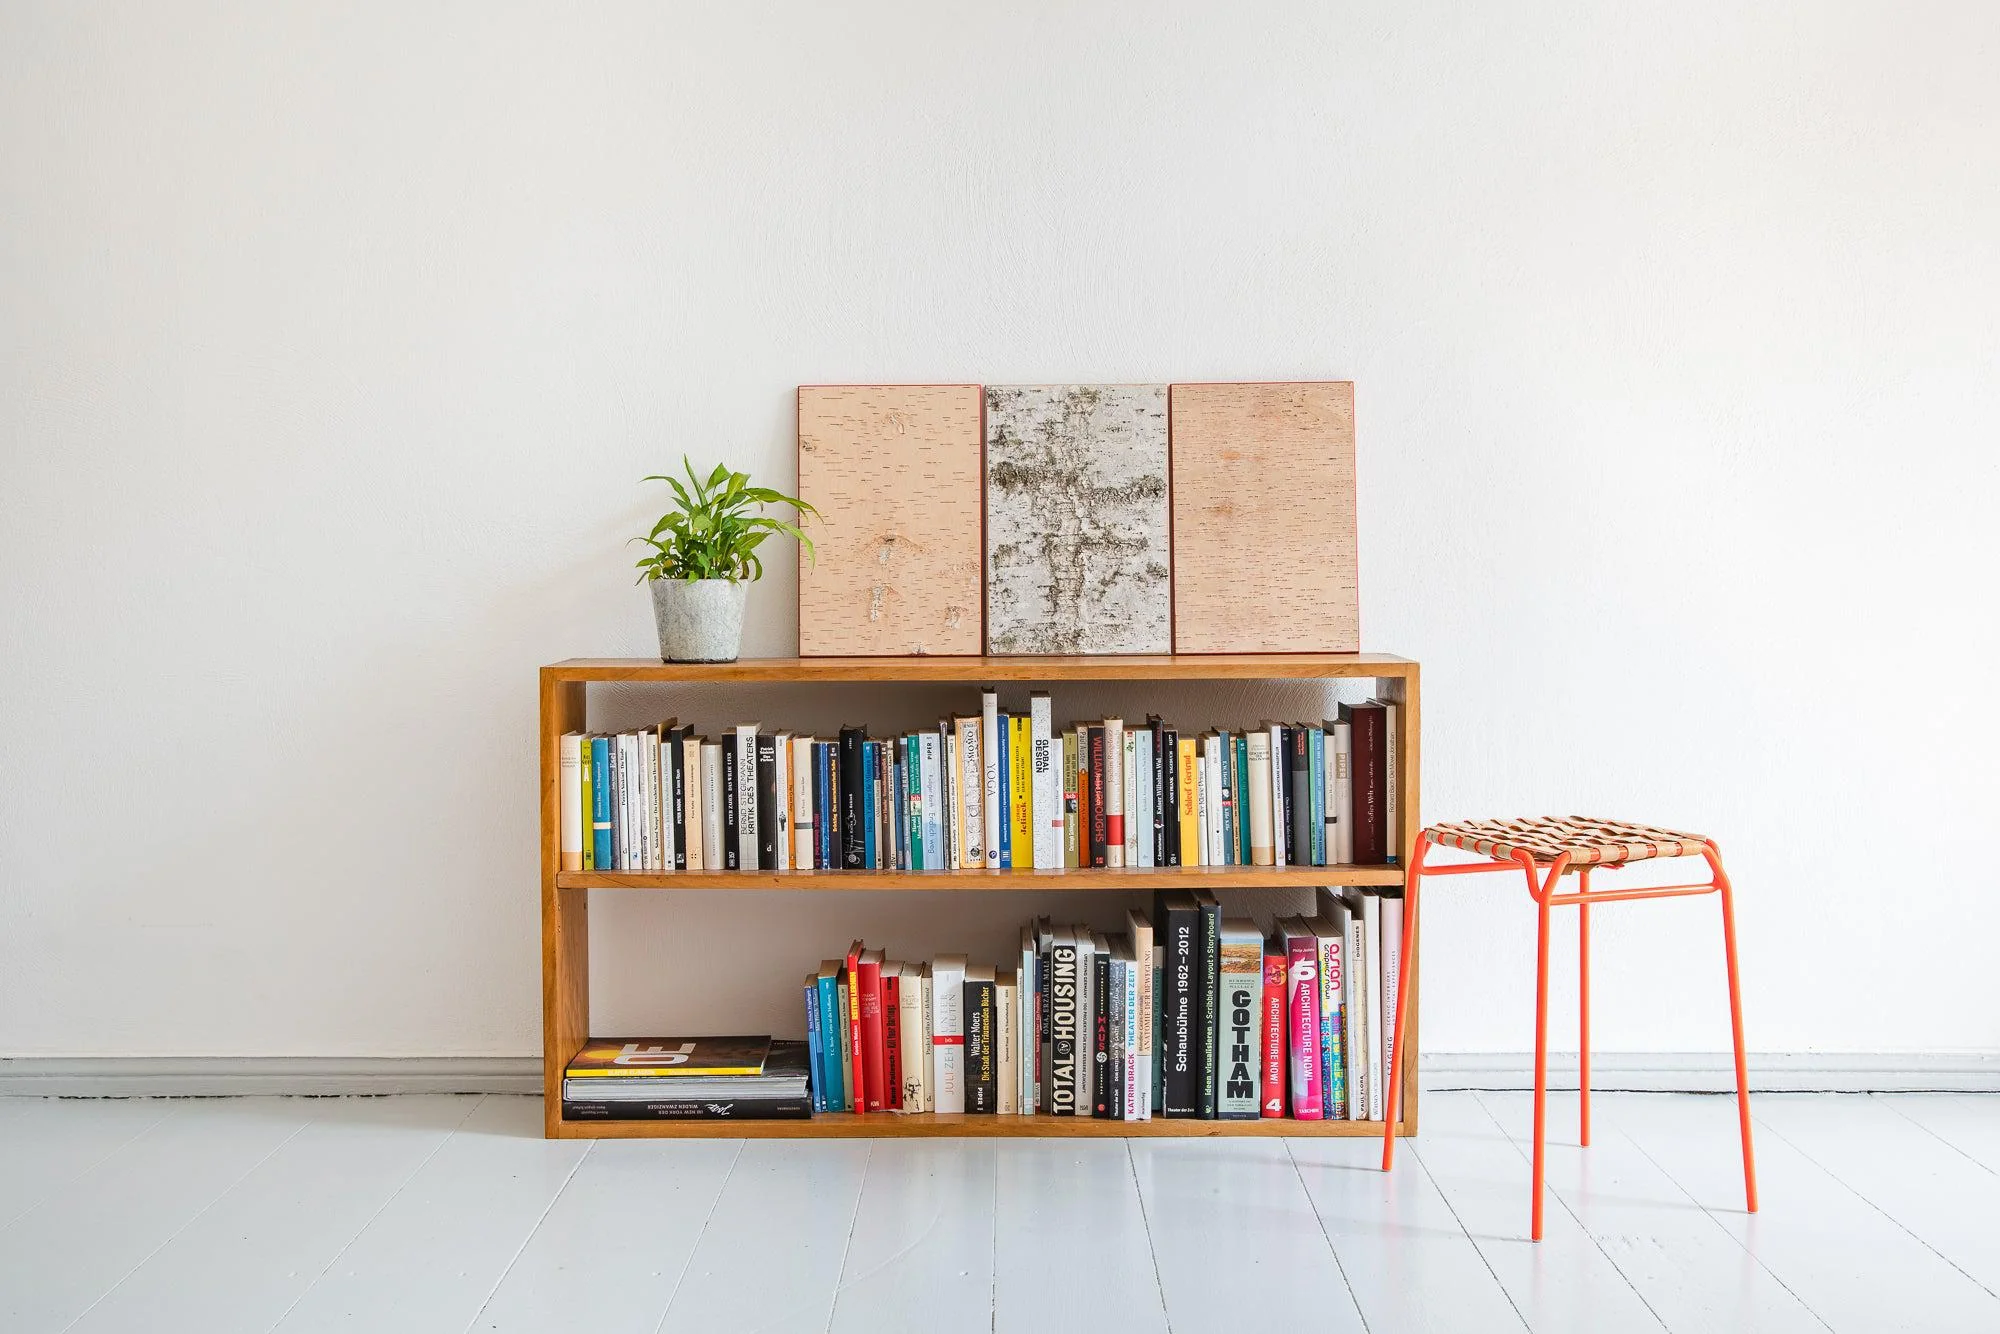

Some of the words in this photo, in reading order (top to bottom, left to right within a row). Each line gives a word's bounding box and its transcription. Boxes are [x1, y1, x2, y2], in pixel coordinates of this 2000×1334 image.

[967, 731, 975, 759] MOMO
[746, 736, 754, 782] THEATERS
[1183, 755, 1191, 784] Gertrud
[987, 763, 996, 797] YOGA
[1184, 789, 1193, 816] Schleef
[747, 807, 755, 835] KRITIK
[928, 812, 936, 837] Endlich
[928, 839, 936, 854] weg
[1207, 913, 1216, 953] Storyboard
[1042, 960, 1050, 980] MAL!
[1177, 927, 1189, 993] 1962–2012
[1206, 959, 1215, 984] Layout
[1329, 943, 1341, 991] asian
[849, 971, 857, 997] LERNEN
[981, 987, 990, 1006] Bücher
[1041, 982, 1050, 1013] ERZÄHL
[1053, 949, 1076, 1040] HOUSING
[1206, 990, 1214, 1019] Scribble
[1301, 983, 1312, 1053] ARCHITECTURE
[971, 1012, 980, 1032] Moers
[981, 1007, 990, 1044] Träumenden
[1042, 1015, 1050, 1035] OMA,
[1175, 997, 1189, 1072] Schaubühne
[1269, 997, 1280, 1060] ARCHITECTURE
[970, 1034, 980, 1056] Walter
[981, 1045, 990, 1054] der
[1205, 1026, 1213, 1073] visualisieren
[1227, 990, 1253, 1098] GOTHAM
[944, 1048, 954, 1069] ZEH
[981, 1056, 990, 1070] Stadt
[1303, 1056, 1313, 1081] NOW!
[944, 1072, 954, 1095] JULI
[982, 1071, 990, 1081] Die
[1053, 1053, 1075, 1114] TOTAL
[1270, 1062, 1279, 1085] NOW!
[704, 1103, 734, 1116] Jazz
[1266, 1098, 1282, 1112] 4
